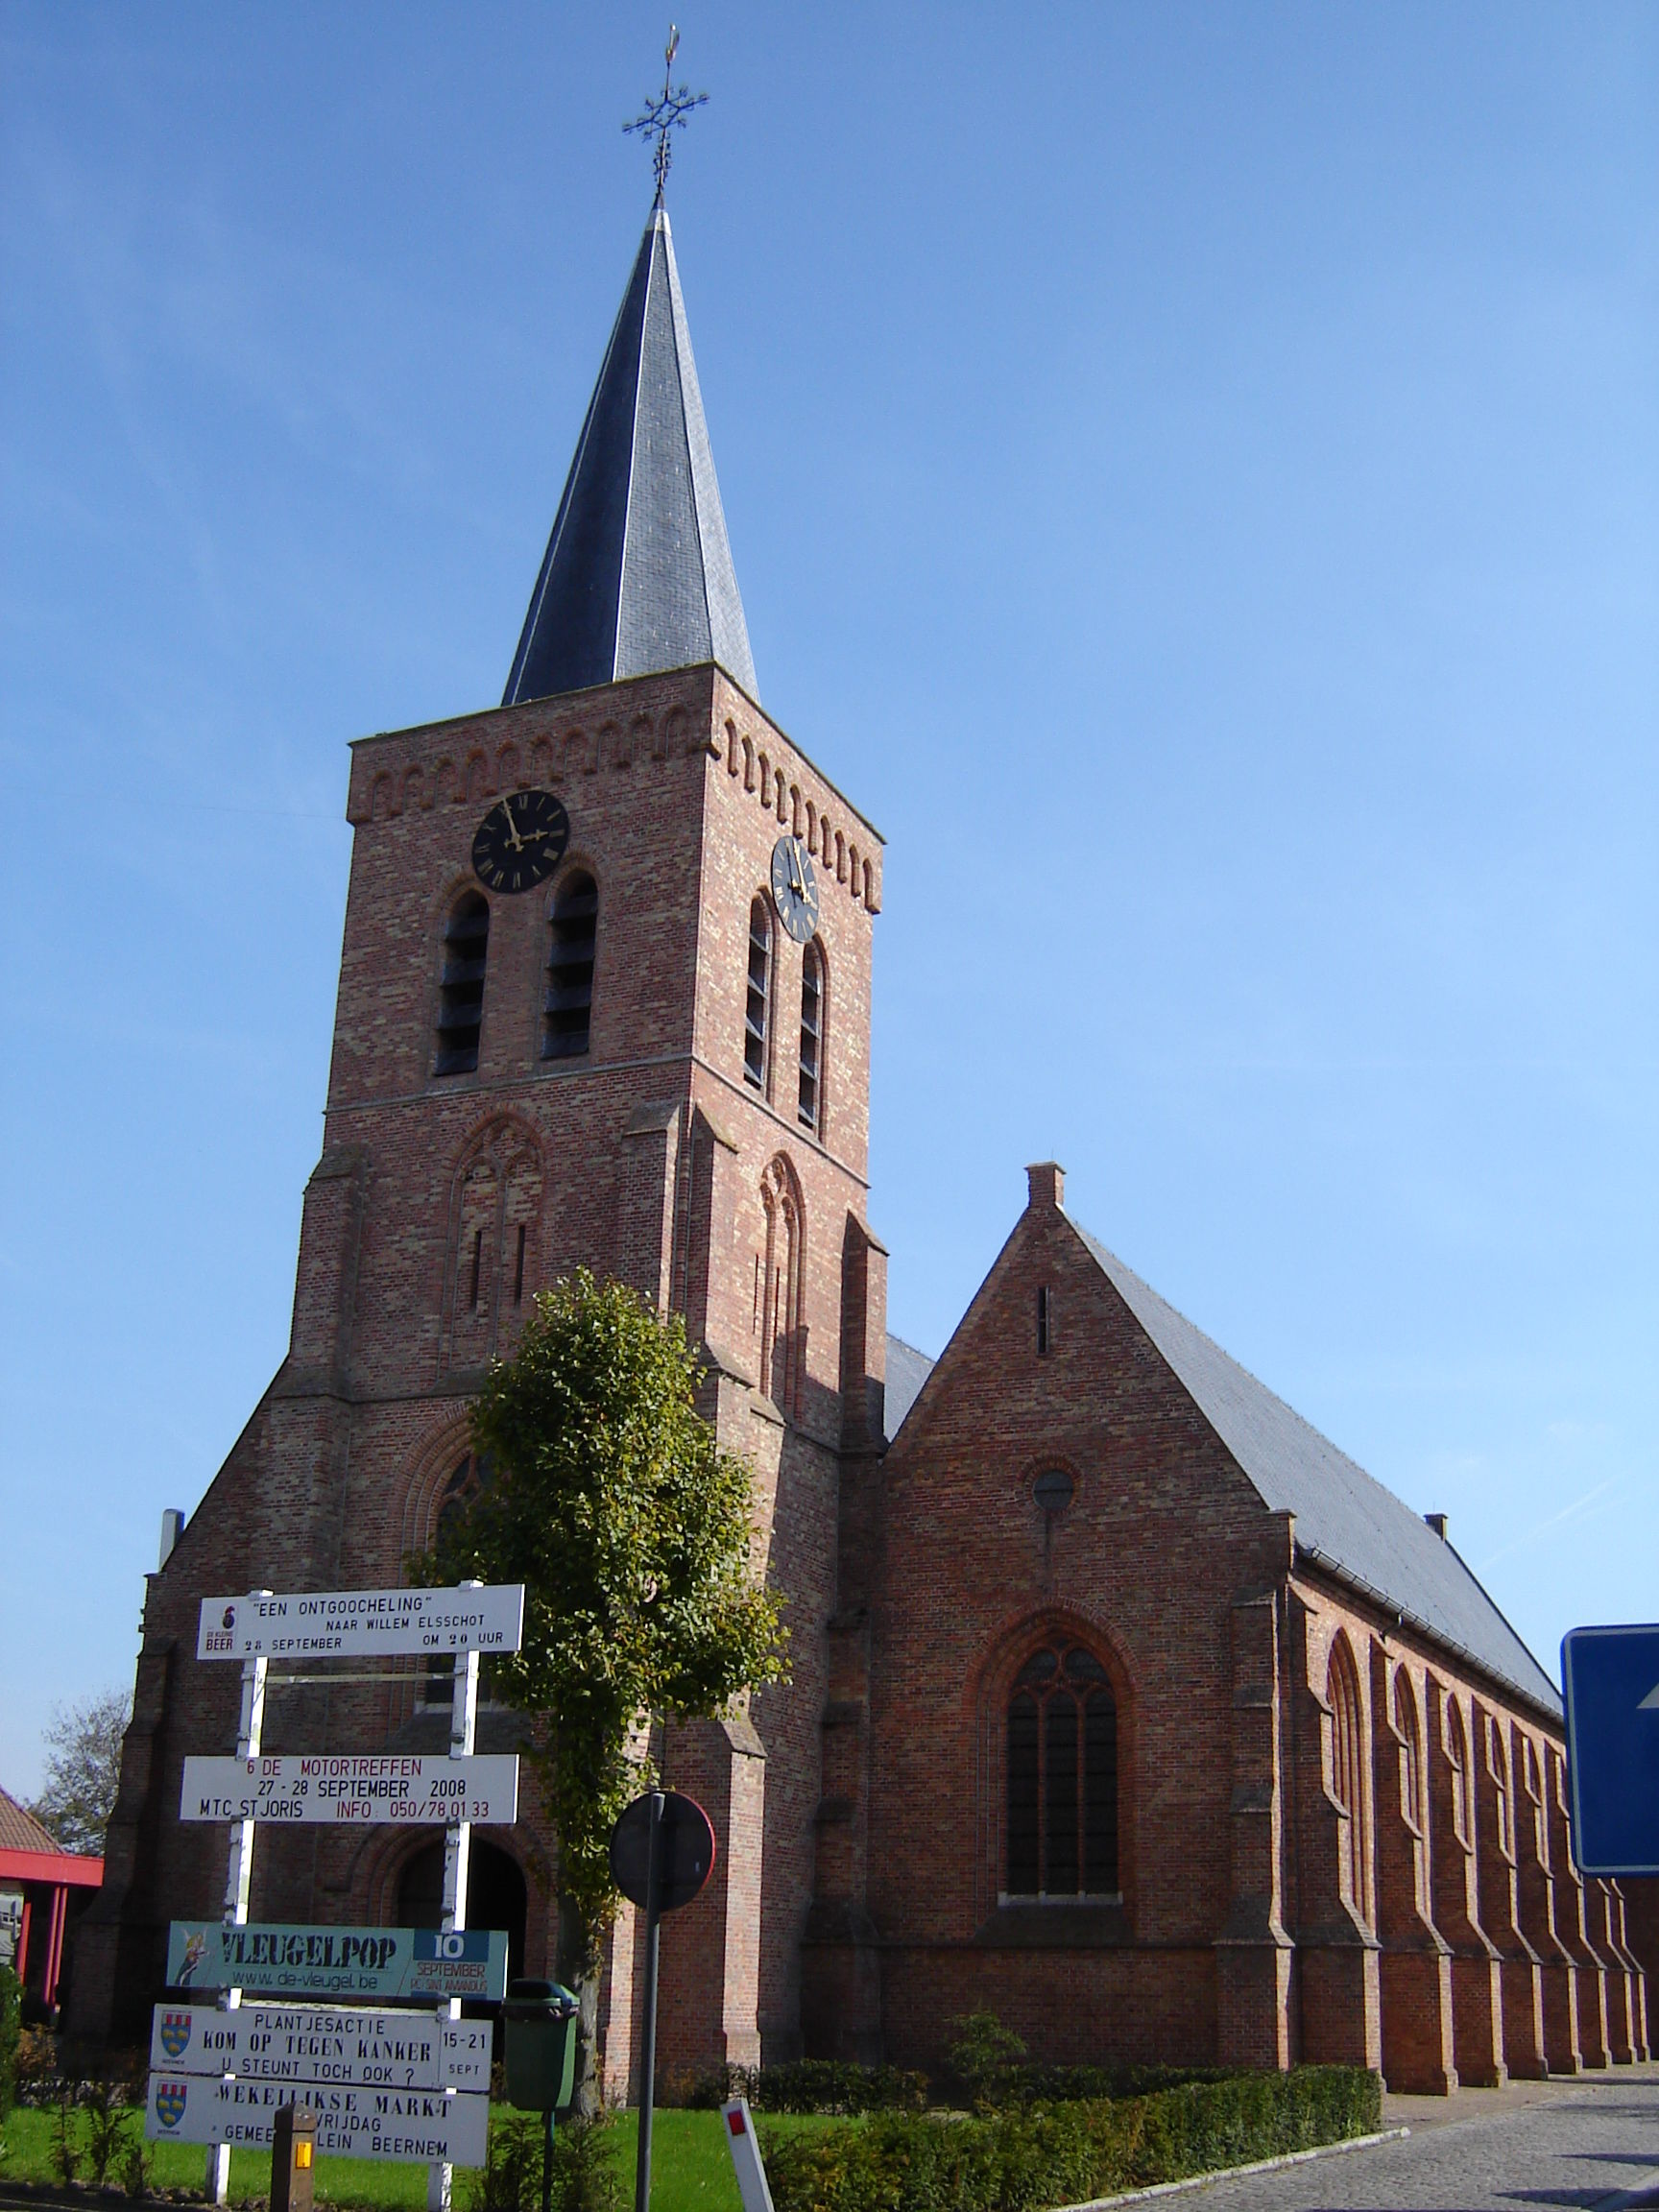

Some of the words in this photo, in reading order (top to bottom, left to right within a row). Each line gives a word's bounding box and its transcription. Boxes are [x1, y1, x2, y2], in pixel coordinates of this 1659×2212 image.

[325, 1619, 358, 1631] NAAR
[367, 1618, 409, 1630] WILLEM
[418, 1615, 485, 1628] ELSSCHOT
[206, 1638, 233, 1650] BEER
[245, 1641, 262, 1651] 28
[272, 1638, 342, 1650] SEPTEMBER
[422, 1635, 439, 1646] OM
[448, 1634, 468, 1645] 20
[478, 1632, 503, 1644] UUR
[247, 1759, 255, 1774] 6
[262, 1759, 282, 1776] DE
[301, 1759, 422, 1776] MOTORTREFFEN
[257, 1780, 275, 1796] 27
[292, 1780, 308, 1796] 28
[318, 1780, 409, 1798] SEPTEMBER
[430, 1780, 467, 1797] 2008
[222, 1932, 397, 1969] VLEUGELPOP
[434, 1934, 465, 1959] 10
[417, 1962, 486, 1978] SEPTEMBER
[254, 2013, 384, 2034] PLANTJESACTIE
[204, 2031, 236, 2051] KOM
[250, 2032, 272, 2053] OP
[286, 2034, 344, 2056] TEGEN
[358, 2039, 431, 2062] KANKER
[444, 2032, 486, 2050] 15-21
[222, 2056, 231, 2072] U
[242, 2057, 300, 2077] STEUNT
[313, 2063, 352, 2080] TOCH
[363, 2066, 393, 2082] OOK
[448, 2063, 480, 2075] SEPT
[375, 2095, 452, 2118] MARKT
[372, 2136, 447, 2156] BEERNEM
